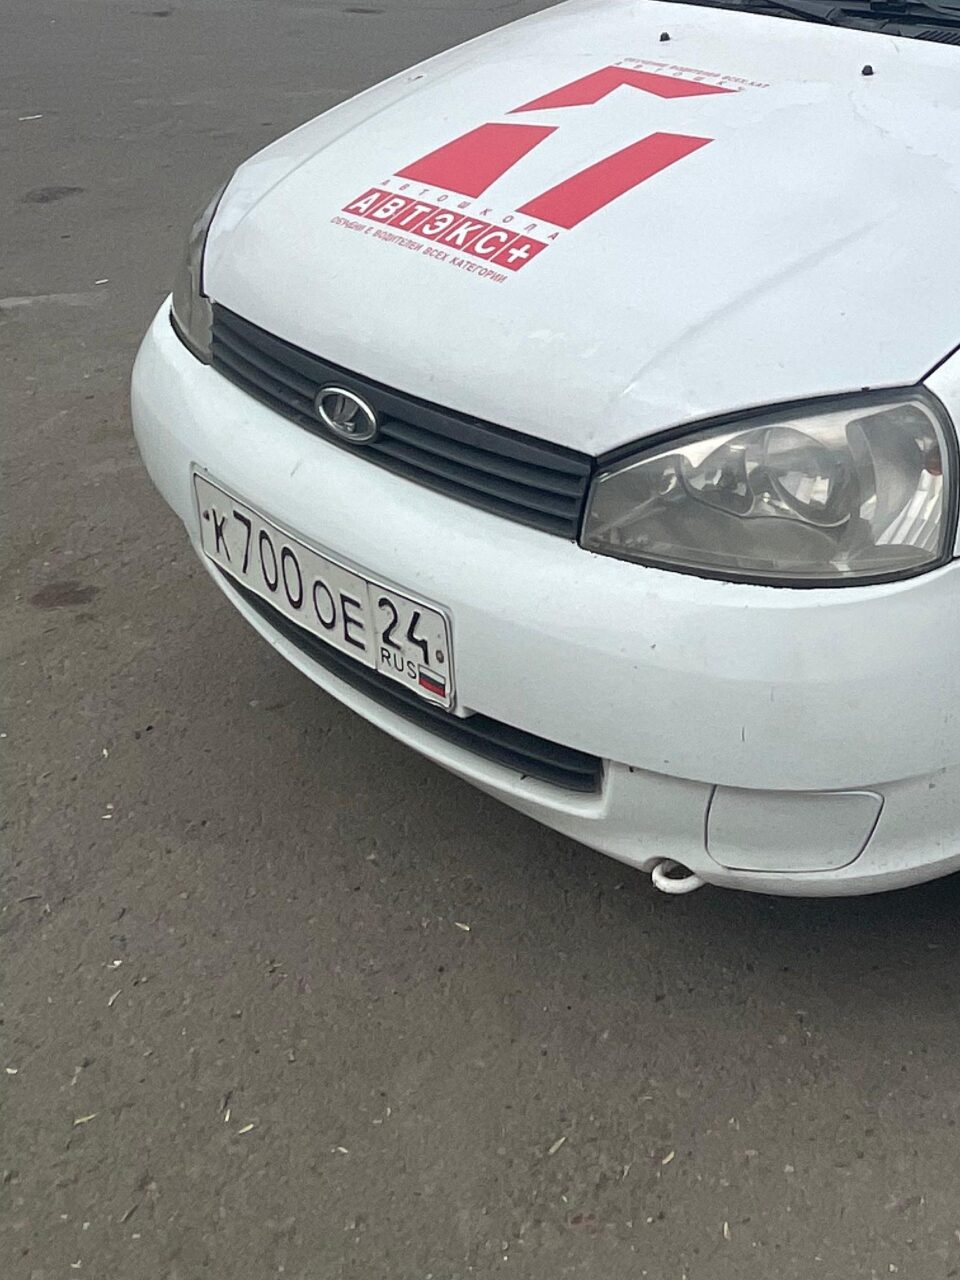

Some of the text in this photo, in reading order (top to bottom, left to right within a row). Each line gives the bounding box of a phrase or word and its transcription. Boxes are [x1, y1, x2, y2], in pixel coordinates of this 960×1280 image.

[347, 190, 533, 265] АВТЭКС+
[381, 179, 561, 241] АВТОШКОЛА
[422, 246, 449, 261] ВСЕХ
[378, 597, 430, 665] 24
[380, 646, 417, 680] RUS
